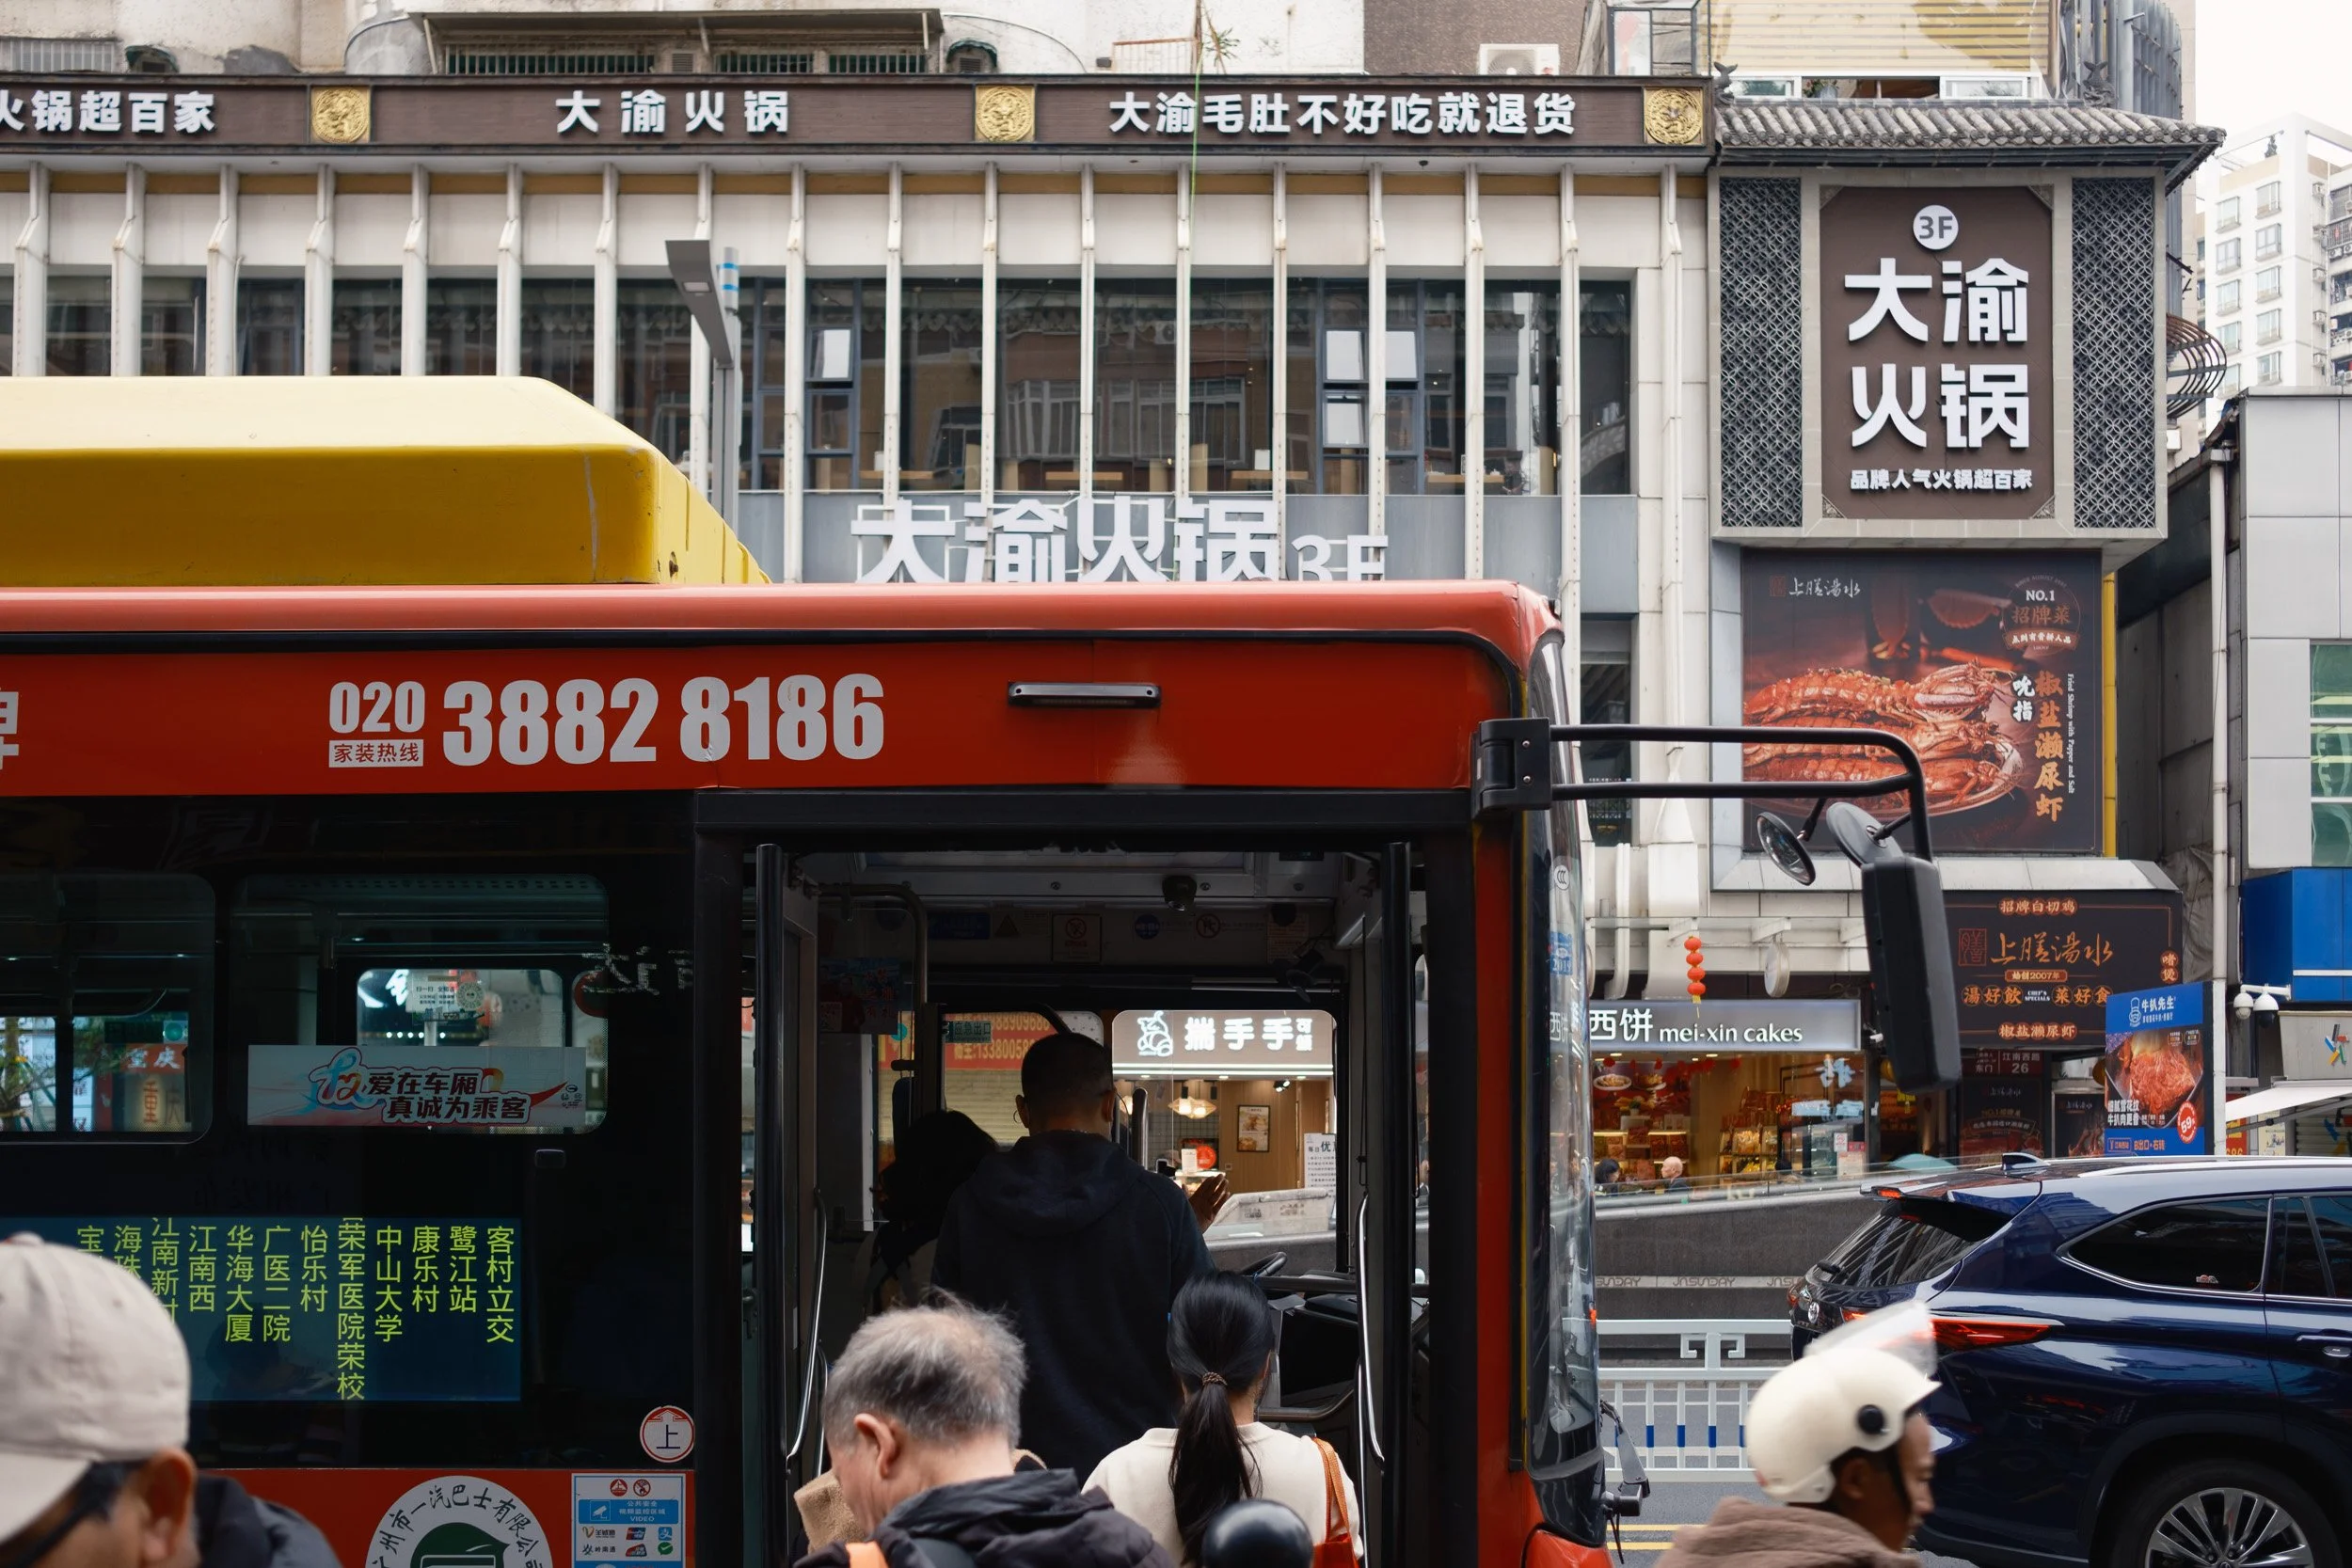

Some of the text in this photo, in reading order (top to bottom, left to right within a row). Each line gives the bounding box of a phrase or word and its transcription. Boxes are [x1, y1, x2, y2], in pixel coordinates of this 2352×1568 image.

[0, 88, 216, 135] 火锅超百家
[555, 89, 789, 135] 大渝火锅
[1108, 90, 1577, 136] 大渝毛肚不好吃就退货
[1918, 215, 1954, 240] 3F
[1844, 257, 2029, 342] 大渝
[1851, 363, 2029, 449] 火锅
[1850, 468, 2033, 491] 品牌人气火锅超百家
[850, 496, 1279, 582] 大渝火锅
[2011, 604, 2071, 626] 招牌菜
[2026, 590, 2055, 602] NO.1
[329, 673, 885, 767] 020 3882 8186
[2012, 674, 2036, 722] 吮指
[334, 742, 420, 763] 家装热线
[2034, 670, 2064, 822] 椒盐濑尿虾
[2000, 899, 2075, 914] 招牌白切鸡
[1589, 1008, 1653, 1042] 西饼
[1660, 1023, 1804, 1042] mei-xin cakes
[2000, 1023, 2075, 1038] 椒盐濑尿虾
[368, 1072, 479, 1095] 爱在车厢
[2011, 1063, 2029, 1074] 26
[387, 1096, 527, 1119] 真诚为乘客
[77, 1226, 103, 1252] 宝
[189, 1226, 215, 1311] 江南西
[226, 1225, 253, 1342] 华海大厦
[262, 1225, 291, 1342] 广医二院
[300, 1226, 327, 1312] 怡乐村
[374, 1226, 403, 1342] 中山大学
[412, 1226, 440, 1312] 康乐村
[449, 1226, 477, 1313] 鹭江站
[485, 1227, 514, 1343] 客村立交
[337, 1217, 366, 1400] 荣军医院荣校
[656, 1424, 680, 1449] 上
